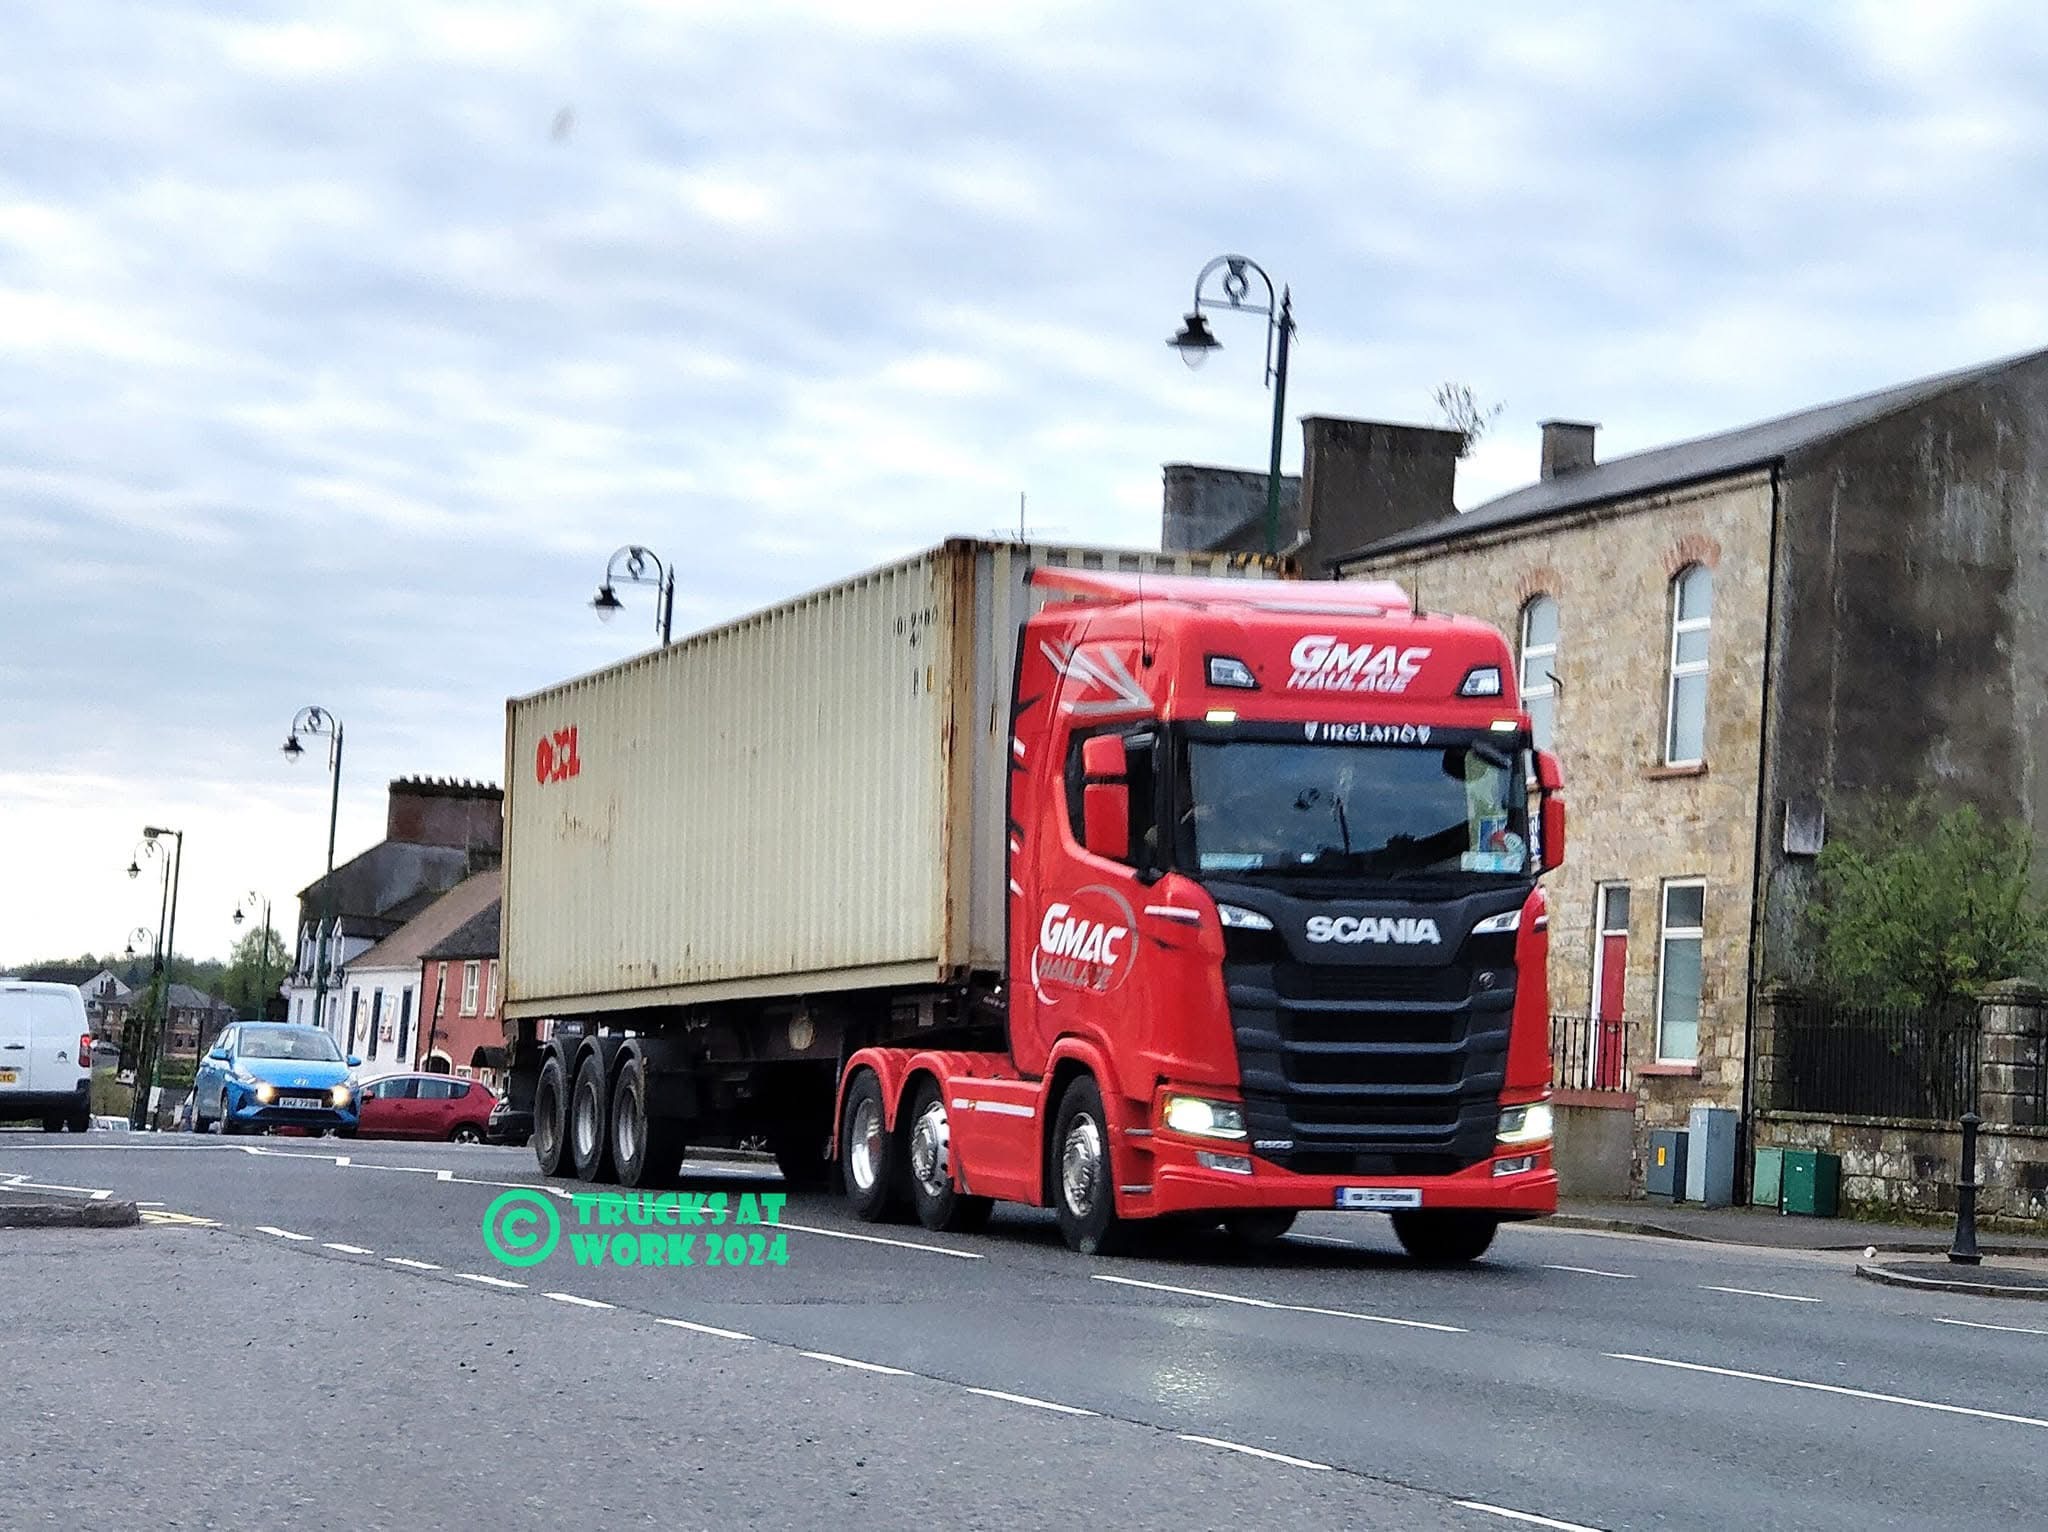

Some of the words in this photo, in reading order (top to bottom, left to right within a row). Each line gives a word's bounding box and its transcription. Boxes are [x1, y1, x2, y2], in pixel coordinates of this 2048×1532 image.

[1290, 635, 1433, 675] GMAC
[1286, 668, 1414, 693] HAULAGE
[1040, 902, 1129, 966] GMAC
[1305, 915, 1442, 945] SCANIA
